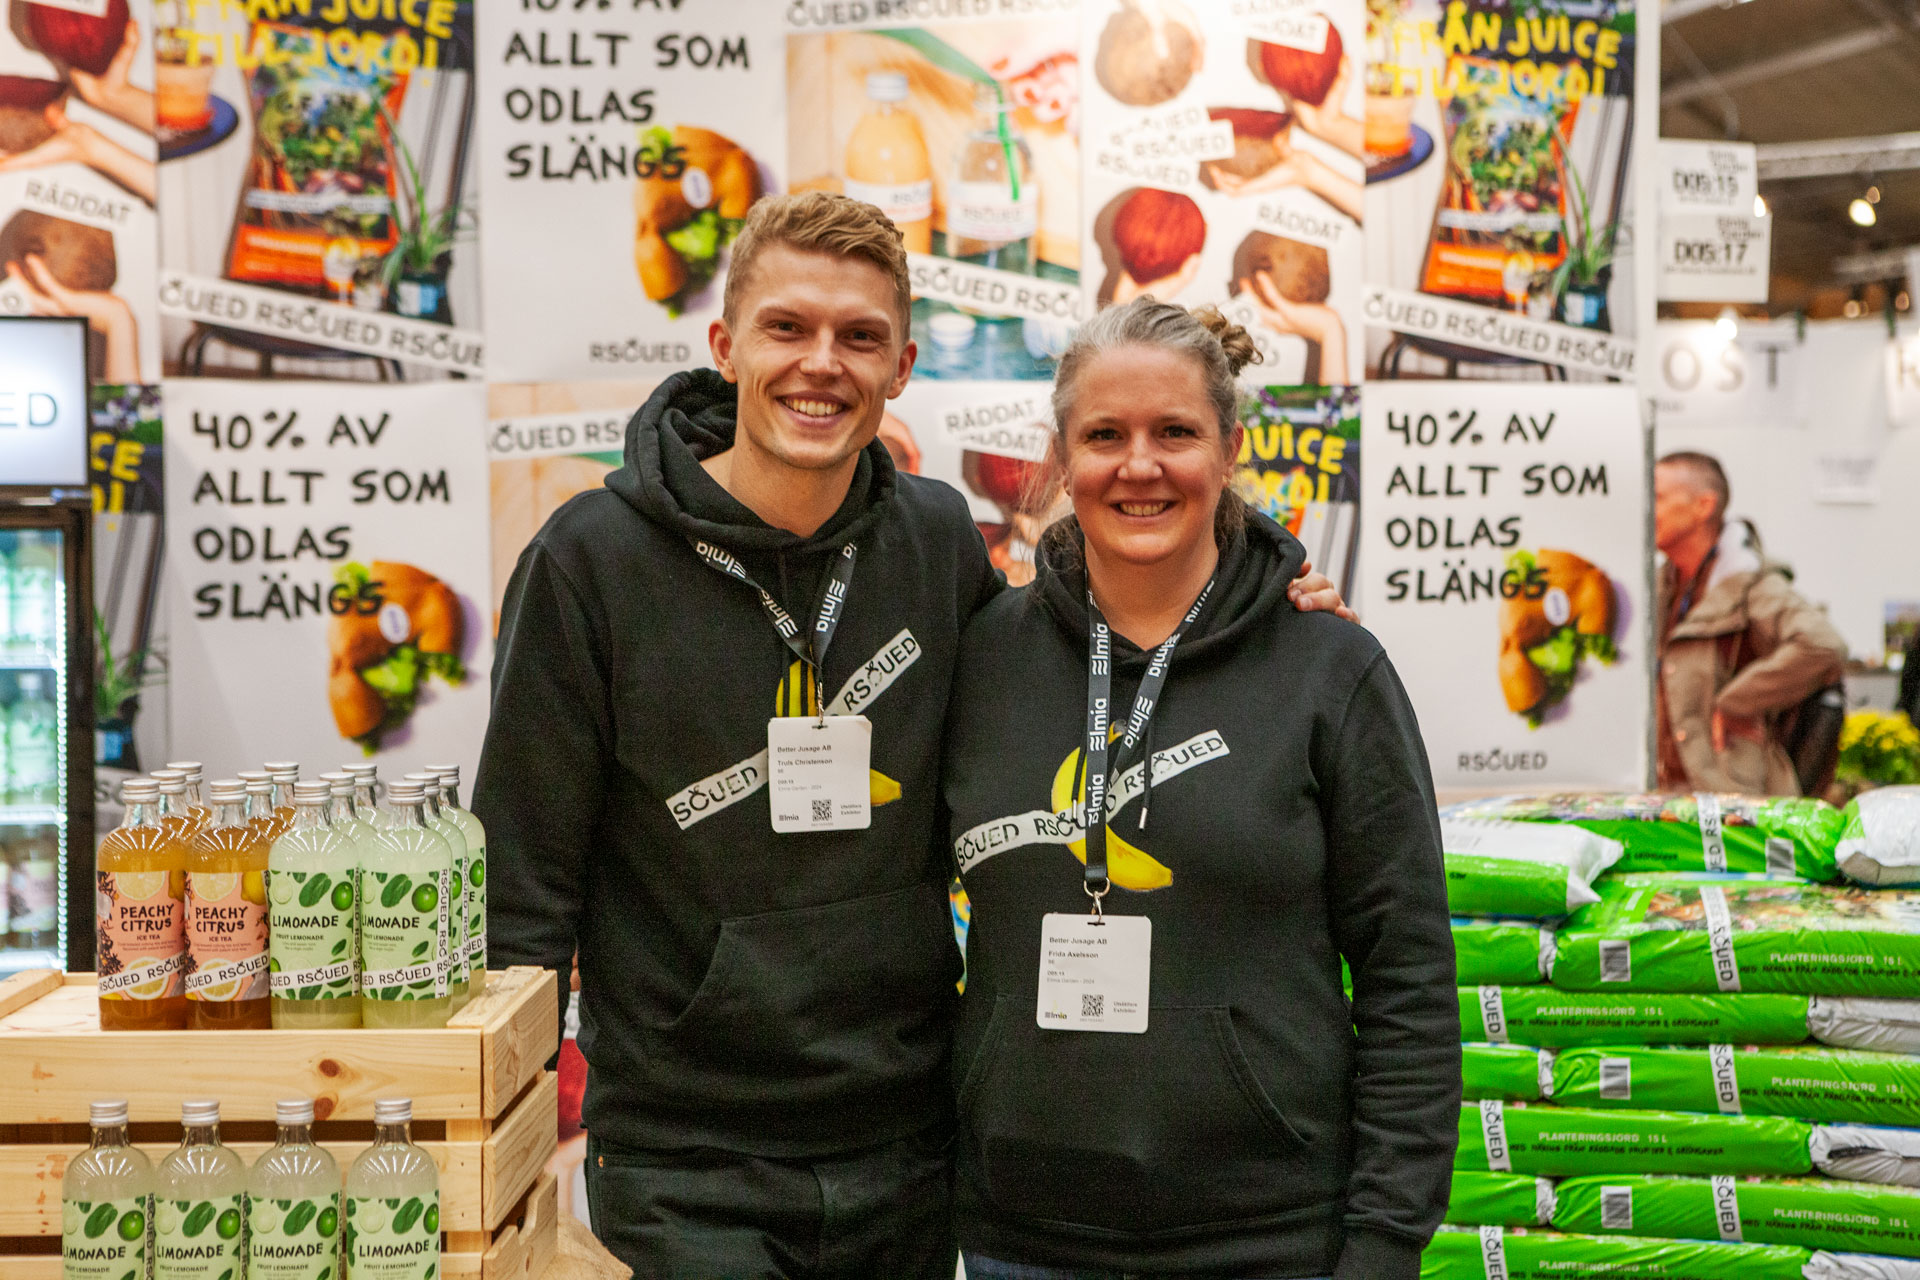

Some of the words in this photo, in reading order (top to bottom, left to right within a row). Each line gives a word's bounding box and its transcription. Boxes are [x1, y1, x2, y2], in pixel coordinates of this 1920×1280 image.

[1393, 0, 1501, 57] FRÅN
[1506, 15, 1622, 69] JUICE
[503, 31, 630, 66] ALLT
[655, 33, 750, 71] SOM
[504, 87, 656, 123] ODLAS
[506, 133, 687, 182] SLÄNGS
[193, 410, 305, 449] 40%
[327, 411, 392, 446] AV
[1386, 409, 1483, 446] 40%
[1503, 411, 1556, 443] AV
[193, 470, 325, 504] ALLT
[351, 469, 452, 504] SOM
[1386, 465, 1500, 496] ALLT
[1523, 464, 1609, 496] SOM
[1385, 516, 1523, 549] ODLAS
[193, 525, 353, 562] ODLAS
[696, 540, 747, 580] Elmia
[1385, 558, 1551, 604] SLÄNGS
[194, 571, 387, 621] SLÄNGS
[815, 577, 847, 634] Elmia
[1091, 622, 1109, 676] Elmia
[1089, 697, 1107, 752] Elmia
[1123, 695, 1154, 749] Elmia
[822, 744, 832, 752] AB
[120, 903, 175, 919] PEACHY
[195, 906, 248, 920] PEACHY
[121, 918, 172, 933] CITRUS
[196, 919, 245, 934] CITRUS
[272, 915, 339, 929] LIMONADE
[1770, 953, 1875, 965] PLANTERINGSJORD
[1536, 1006, 1636, 1017] PLANTERINGSJORD
[1771, 1077, 1876, 1092] PLANTERINGSJORD
[1538, 1132, 1640, 1143] PLANTERINGSJORD
[1773, 1208, 1880, 1225] PLANTERINGSJORD
[63, 1246, 126, 1261] LIMONADE
[156, 1244, 224, 1260] LIMONADE
[254, 1242, 323, 1258] LIMONADE
[359, 1239, 430, 1258] LIMONADE
[173, 1265, 209, 1273] LEMONADE
[272, 1263, 309, 1272] LEMONADE
[382, 1261, 418, 1271] LEMONADE
